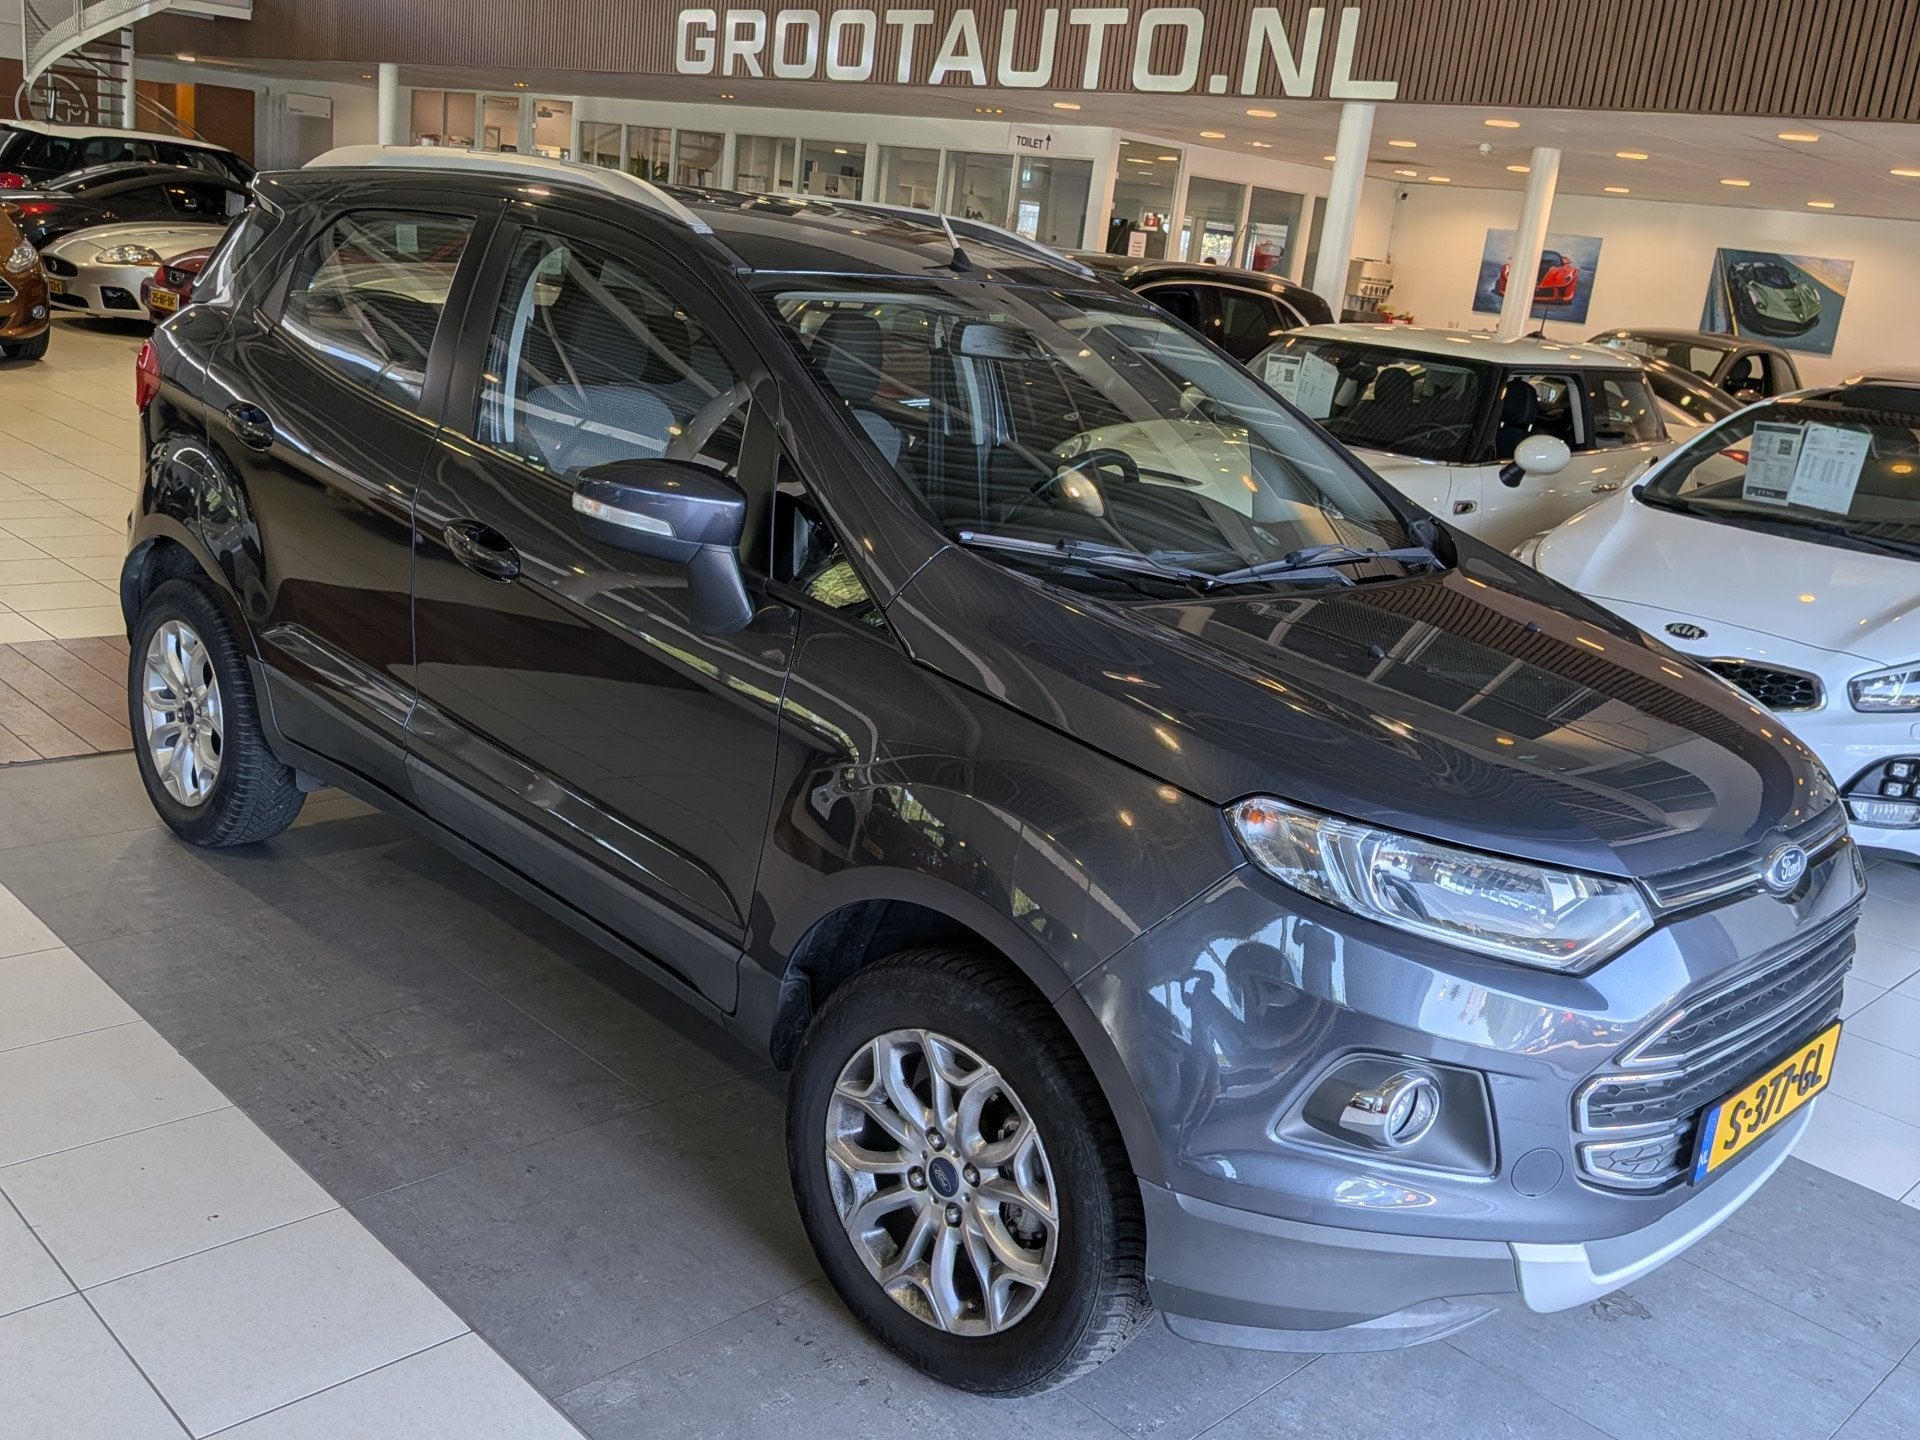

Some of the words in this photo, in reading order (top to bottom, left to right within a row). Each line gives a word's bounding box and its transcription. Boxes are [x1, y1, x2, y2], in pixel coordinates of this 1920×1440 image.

[675, 7, 1398, 99] GROOTAUTO.NL
[1017, 135, 1044, 149] TOILET
[1669, 623, 1701, 639] KIA
[1779, 852, 1803, 881] Ford
[1723, 1043, 1825, 1150] S-377-GL
[1697, 1149, 1709, 1169] NL
